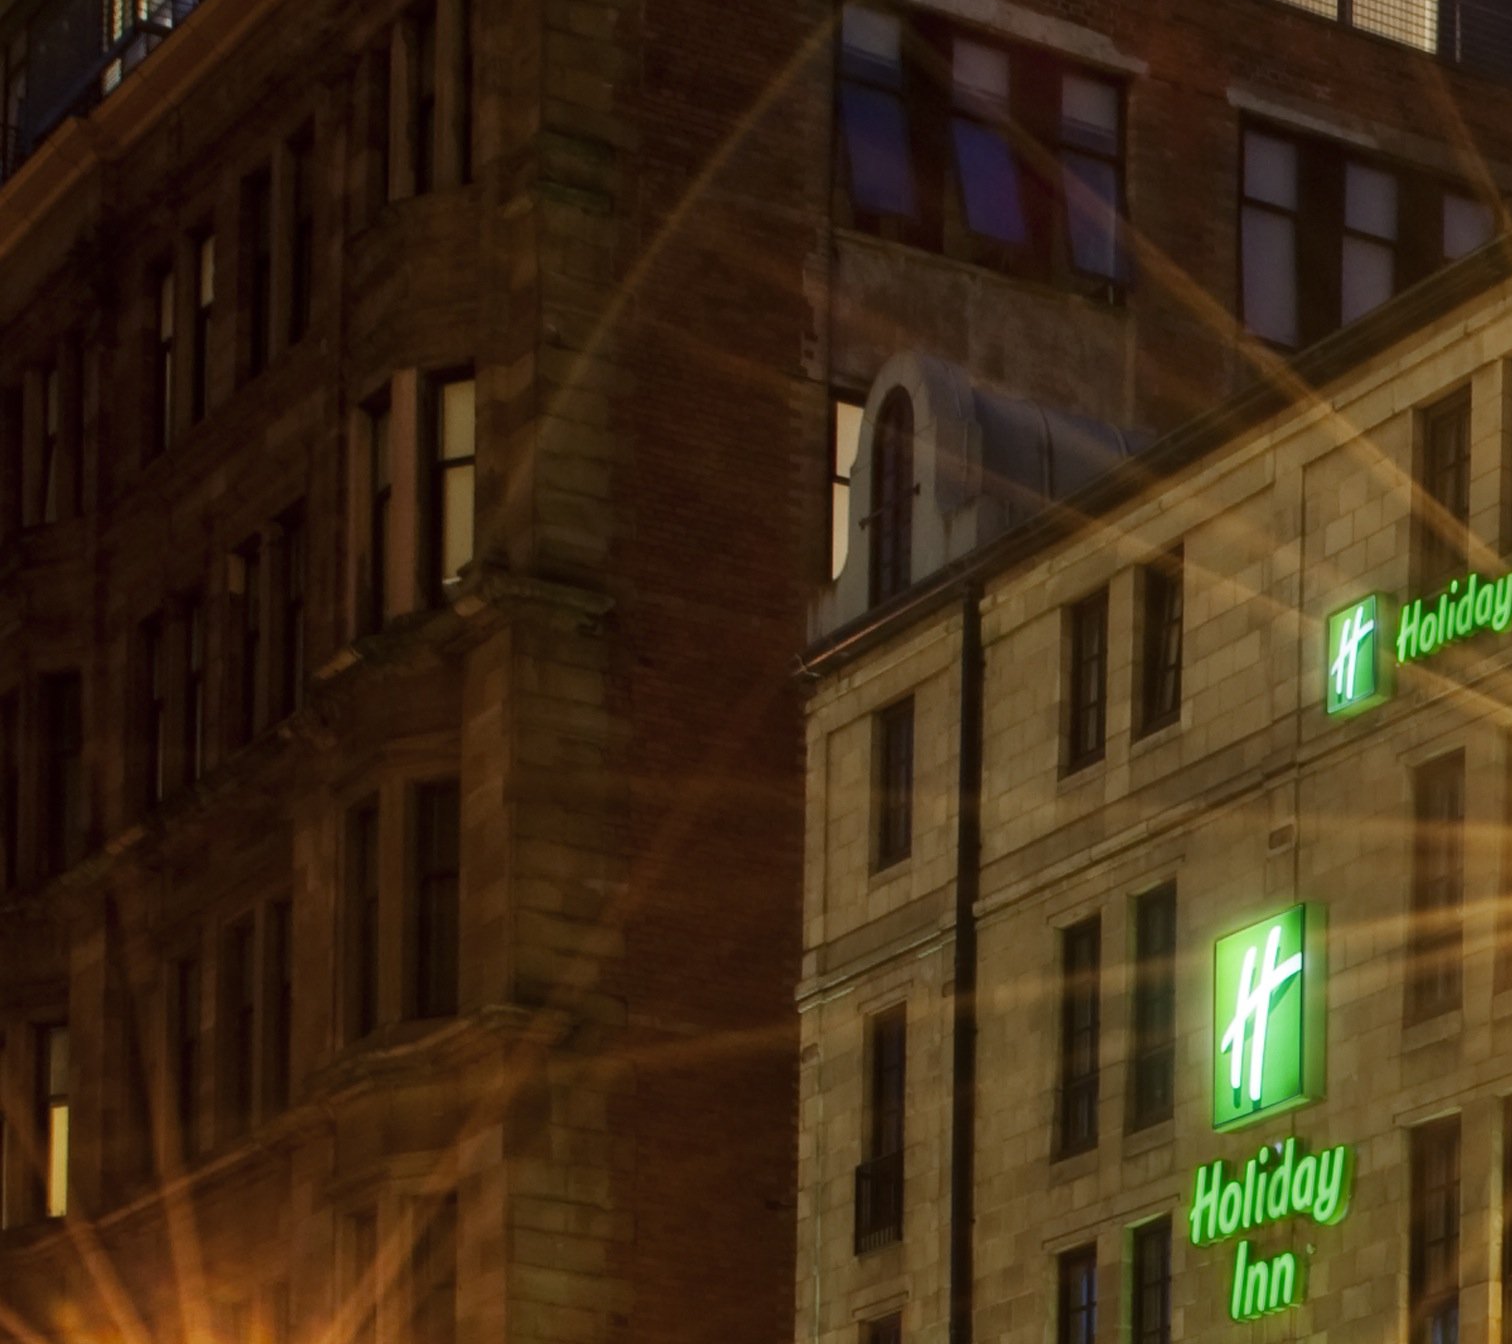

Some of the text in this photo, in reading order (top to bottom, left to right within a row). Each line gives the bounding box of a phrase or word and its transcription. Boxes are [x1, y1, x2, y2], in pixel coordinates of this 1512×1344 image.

[1397, 572, 1512, 665] Holiday
[1190, 1137, 1348, 1244] Holiday
[1231, 1240, 1296, 1321] Inn
